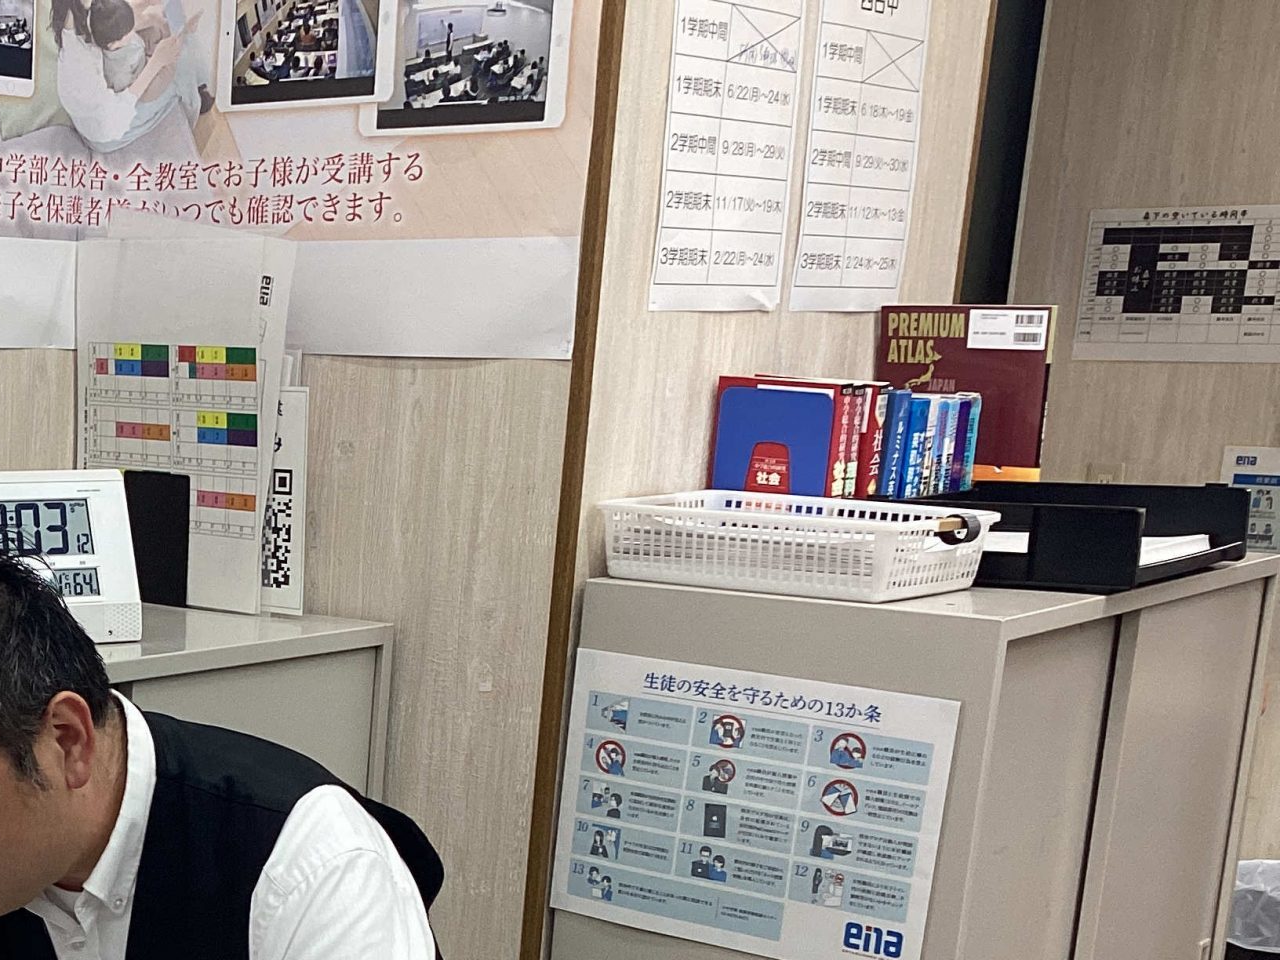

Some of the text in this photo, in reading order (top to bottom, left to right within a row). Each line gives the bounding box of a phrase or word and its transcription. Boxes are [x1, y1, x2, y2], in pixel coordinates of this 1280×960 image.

[681, 17, 728, 41] 1学期中間
[823, 42, 863, 64] 1学期中間
[677, 75, 722, 98] 1学期期末
[818, 96, 857, 116] 1学期期末
[671, 132, 716, 155] 2学期中間
[811, 149, 851, 168] 2学期中間
[666, 191, 712, 211] 2学期期末
[807, 201, 847, 219] 2学期期末
[660, 247, 708, 266] 3学期期末
[801, 252, 842, 270] 3学期期末
[888, 312, 965, 338] PREMIUM
[887, 339, 935, 363] ATLAS
[927, 378, 956, 392] JAPAN
[1236, 455, 1257, 466] ena
[756, 471, 781, 486] 社会
[592, 695, 599, 706] 1
[642, 672, 882, 723] 生徒の安全を守るための13か条
[698, 712, 708, 723] 2
[586, 738, 594, 749] 4
[814, 730, 823, 743] 3
[692, 755, 701, 767] 5
[583, 779, 590, 790] 7
[807, 775, 817, 788] 6
[686, 800, 695, 811] 8
[576, 820, 589, 832] 10
[800, 820, 810, 832] 9
[680, 842, 693, 855] 11
[572, 862, 585, 874] 13
[794, 865, 809, 877] 12
[843, 922, 903, 958] ena
